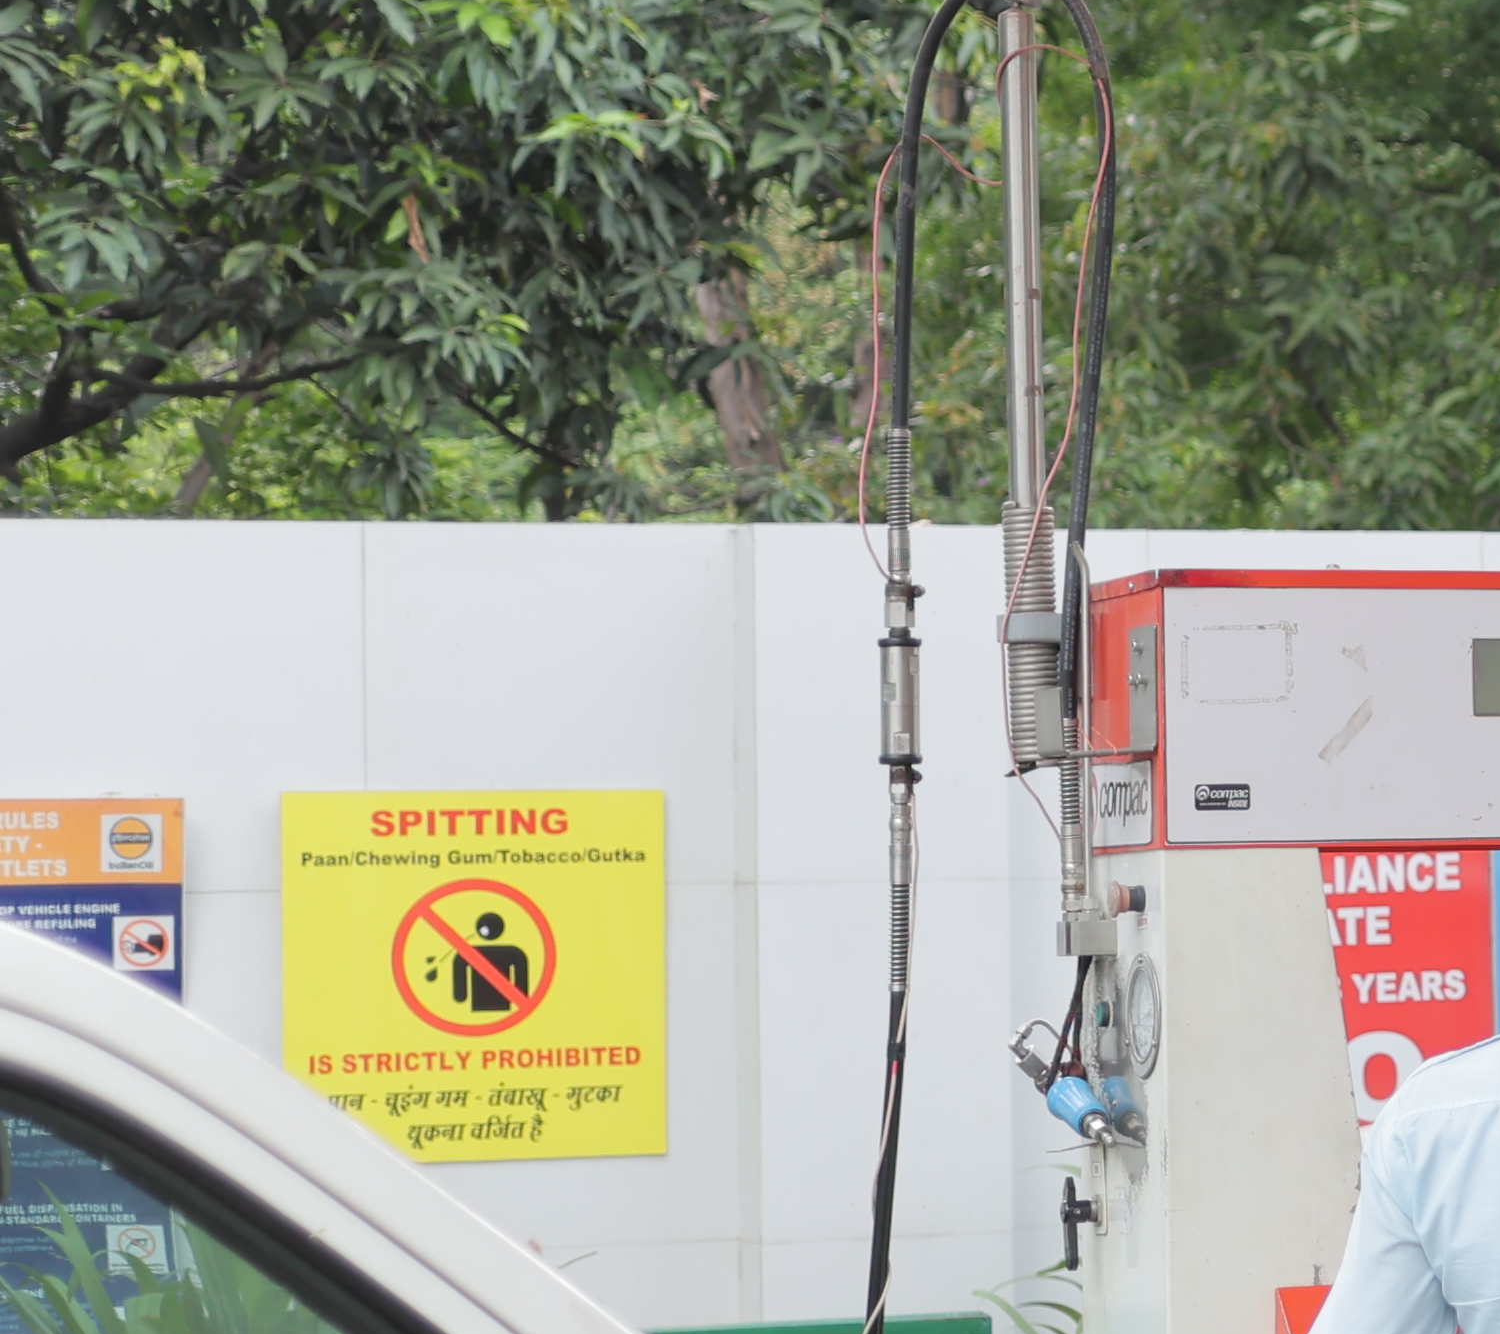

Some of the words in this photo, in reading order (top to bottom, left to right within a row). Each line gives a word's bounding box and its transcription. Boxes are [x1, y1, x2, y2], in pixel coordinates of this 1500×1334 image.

[1100, 779, 1148, 827] compac
[1210, 789, 1249, 799] compac
[371, 809, 569, 837] SPITTING
[0, 859, 67, 878] TLETS
[301, 850, 441, 868] Paan/Chewing
[447, 848, 646, 866] Gum/Tobacco/Gutka
[18, 903, 71, 916] VEHICLE
[74, 902, 120, 915] ENGINE
[1350, 969, 1467, 1004] YEARS
[309, 1054, 333, 1075] IS
[342, 1050, 472, 1074] STRICTLY
[482, 1046, 642, 1071] PROHIBITED
[435, 1089, 469, 1107] गम
[566, 1084, 623, 1110] गुटका
